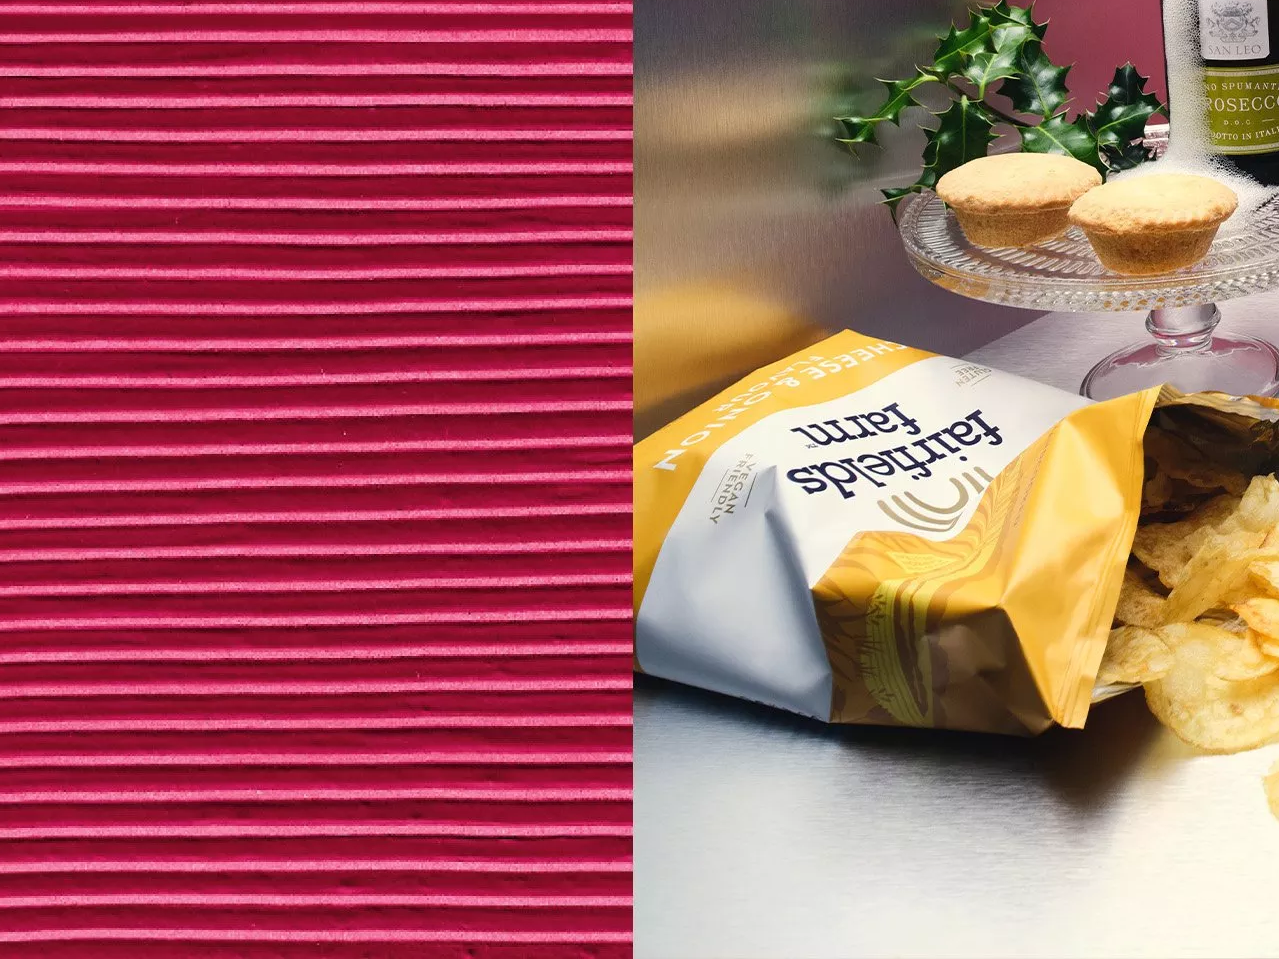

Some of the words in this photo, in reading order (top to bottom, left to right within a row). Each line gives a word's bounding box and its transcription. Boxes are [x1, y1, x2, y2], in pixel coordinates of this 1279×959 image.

[1208, 45, 1231, 55] SAN
[1236, 44, 1262, 55] LEO
[653, 391, 773, 472] ONION
[786, 409, 1003, 500] fairfields
[790, 402, 922, 446] farm
[709, 452, 754, 525] FRIENDLY
[723, 462, 757, 514] VEGAN
